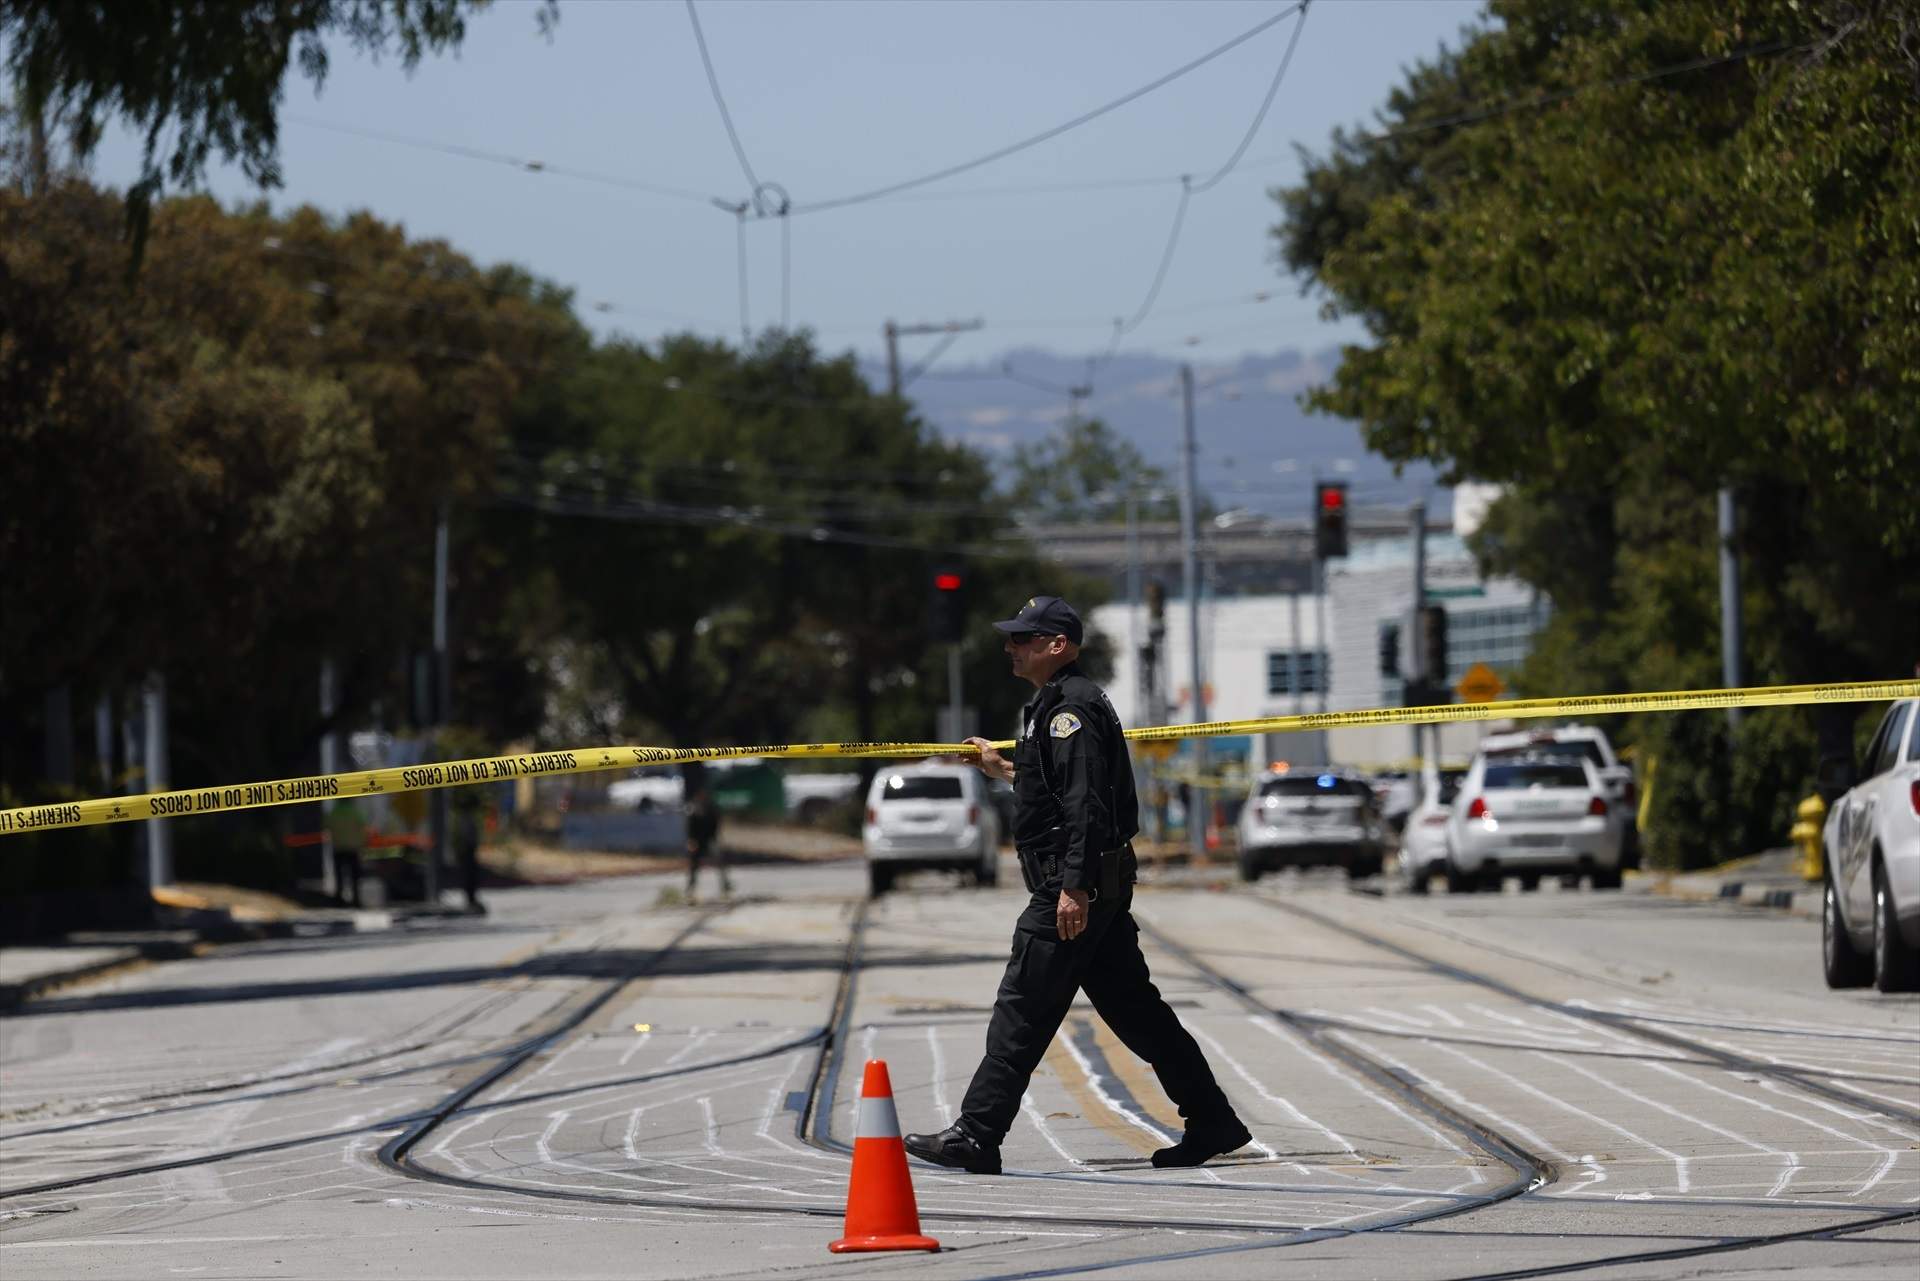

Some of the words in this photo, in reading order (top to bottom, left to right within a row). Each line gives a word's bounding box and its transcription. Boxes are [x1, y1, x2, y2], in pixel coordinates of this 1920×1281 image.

[633, 748, 671, 763] CROSS
[674, 747, 695, 760] NOT
[473, 762, 488, 779] DO
[493, 759, 518, 777] LINE
[522, 753, 577, 774] SHERIFF'S
[403, 767, 442, 788] CROSS
[446, 764, 469, 783] NOT
[224, 789, 241, 808] DO
[247, 785, 273, 805] LINE
[278, 778, 338, 801] SHERIFF'S
[150, 794, 192, 815] CROSS
[196, 791, 220, 811] NOT
[0, 813, 13, 831] LI
[17, 805, 81, 829] SHERIFF'S
